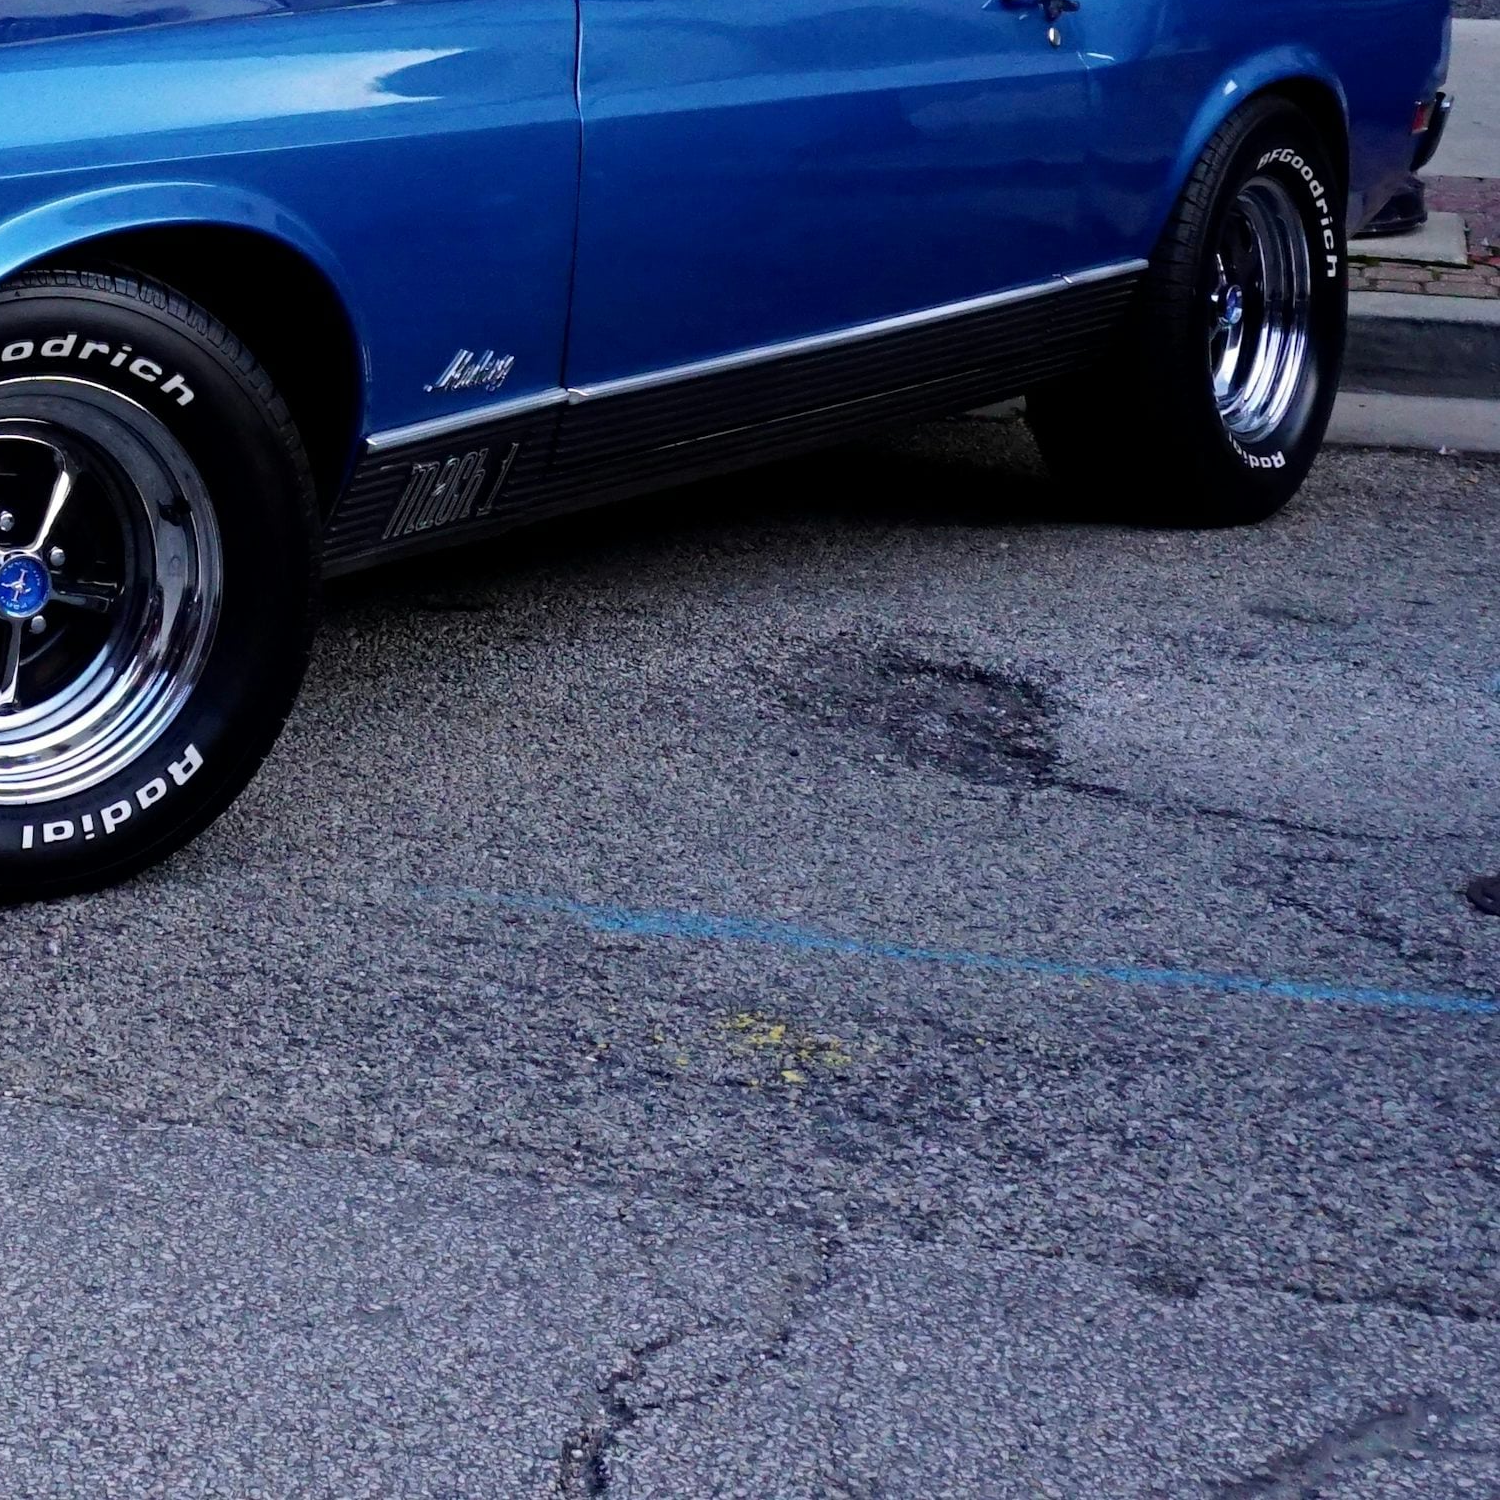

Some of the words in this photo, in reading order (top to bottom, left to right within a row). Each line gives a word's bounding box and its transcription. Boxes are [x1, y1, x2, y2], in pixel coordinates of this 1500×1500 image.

[1256, 148, 1338, 278] BFGoodrich
[1228, 431, 1286, 469] Radial
[22, 743, 204, 849] Radial
